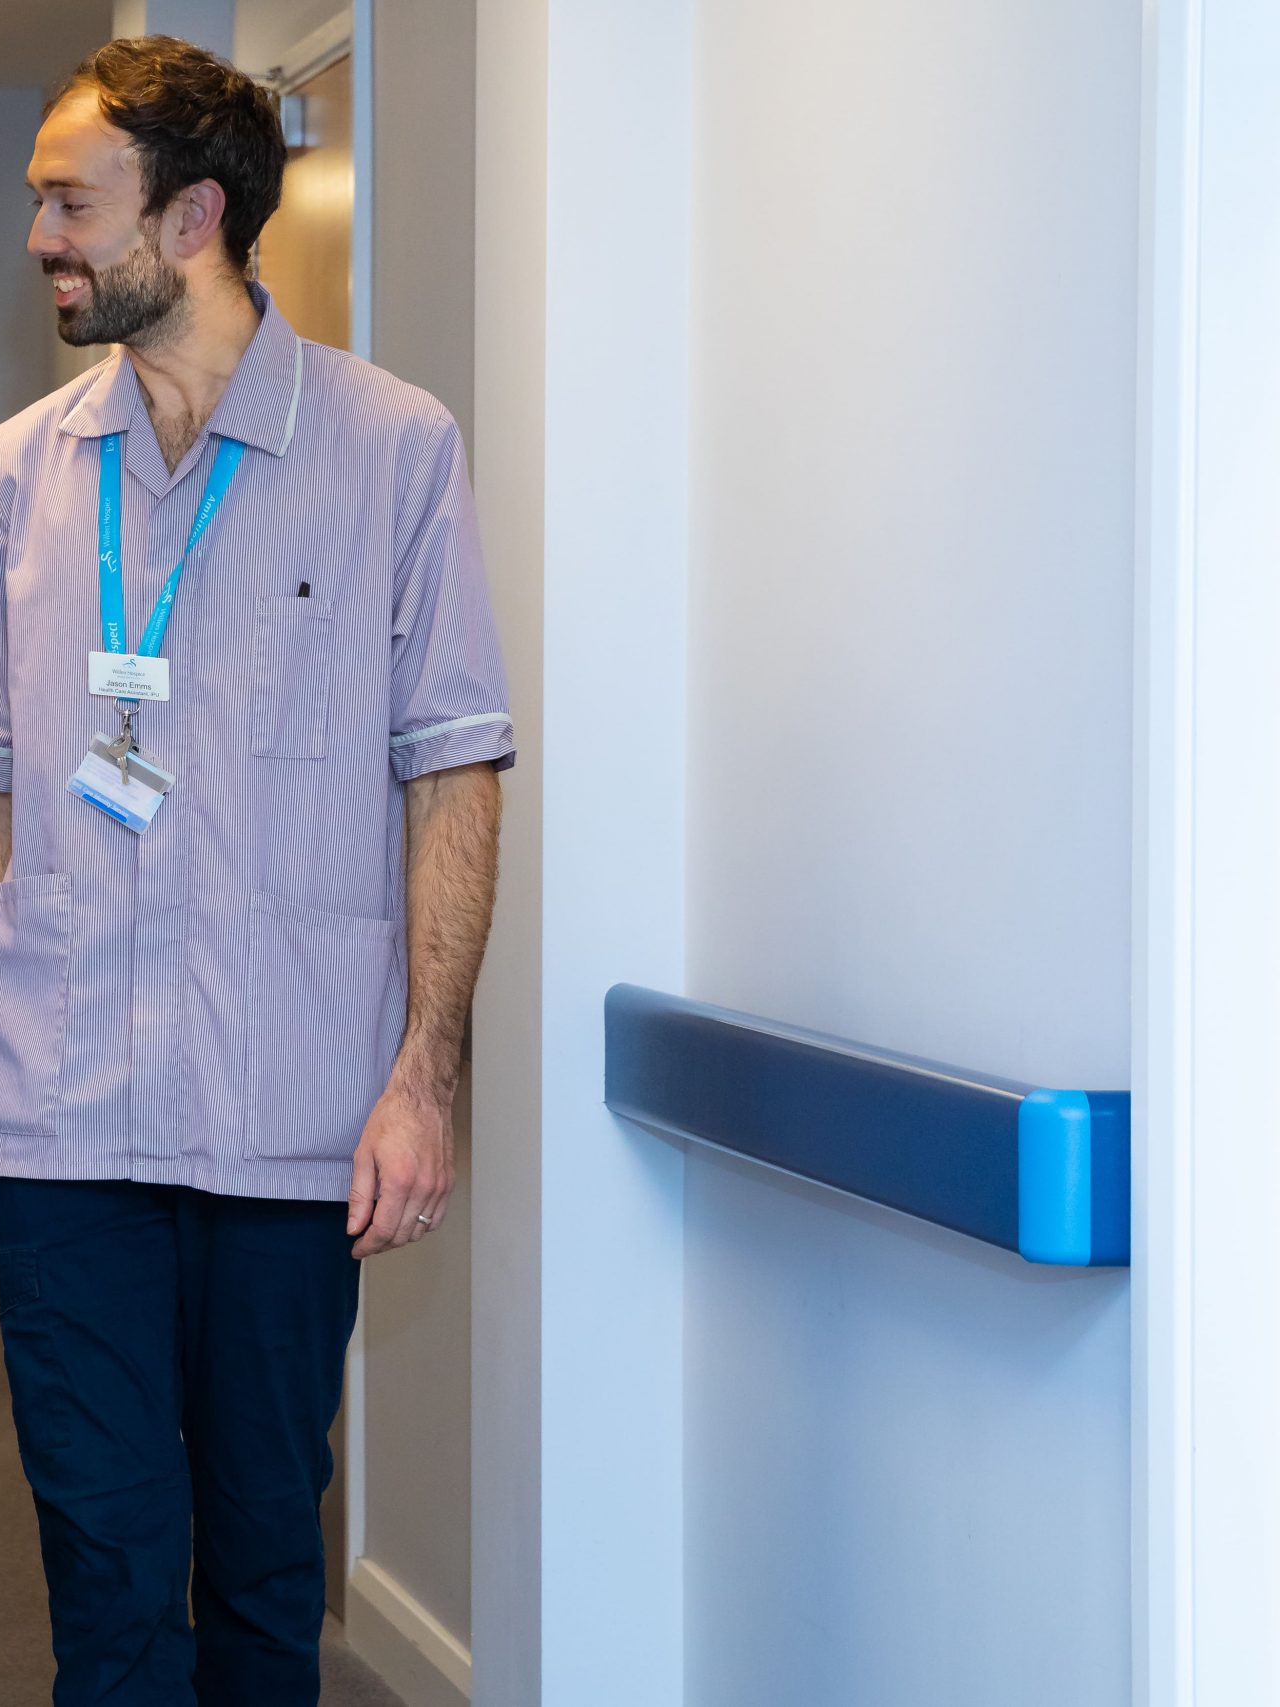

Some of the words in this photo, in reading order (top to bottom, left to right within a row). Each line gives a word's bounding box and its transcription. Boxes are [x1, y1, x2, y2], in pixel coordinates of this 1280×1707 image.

[103, 497, 112, 524] Hospice
[107, 622, 121, 654] espect
[106, 680, 128, 688] Jason
[129, 681, 152, 691] Emms
